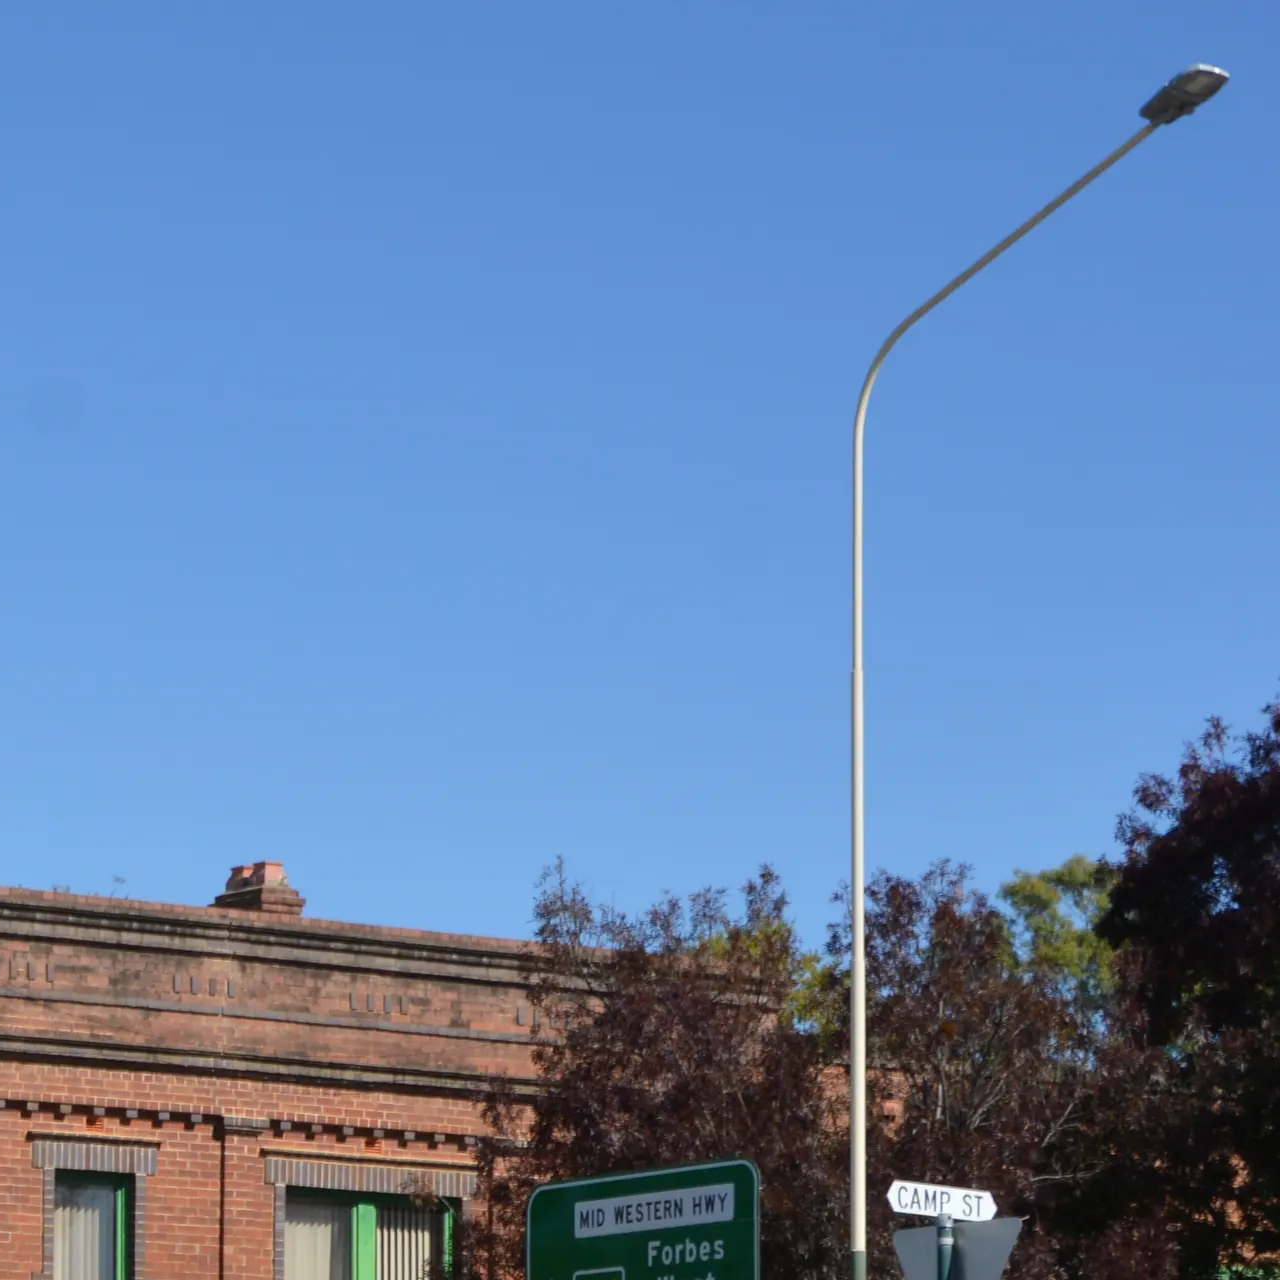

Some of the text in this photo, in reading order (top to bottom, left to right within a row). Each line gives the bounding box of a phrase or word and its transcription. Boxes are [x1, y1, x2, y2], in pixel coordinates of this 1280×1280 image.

[579, 1192, 729, 1229] MID WESTERN HWY
[898, 1186, 984, 1218] CAMP ST
[648, 1238, 725, 1267] Forbes
